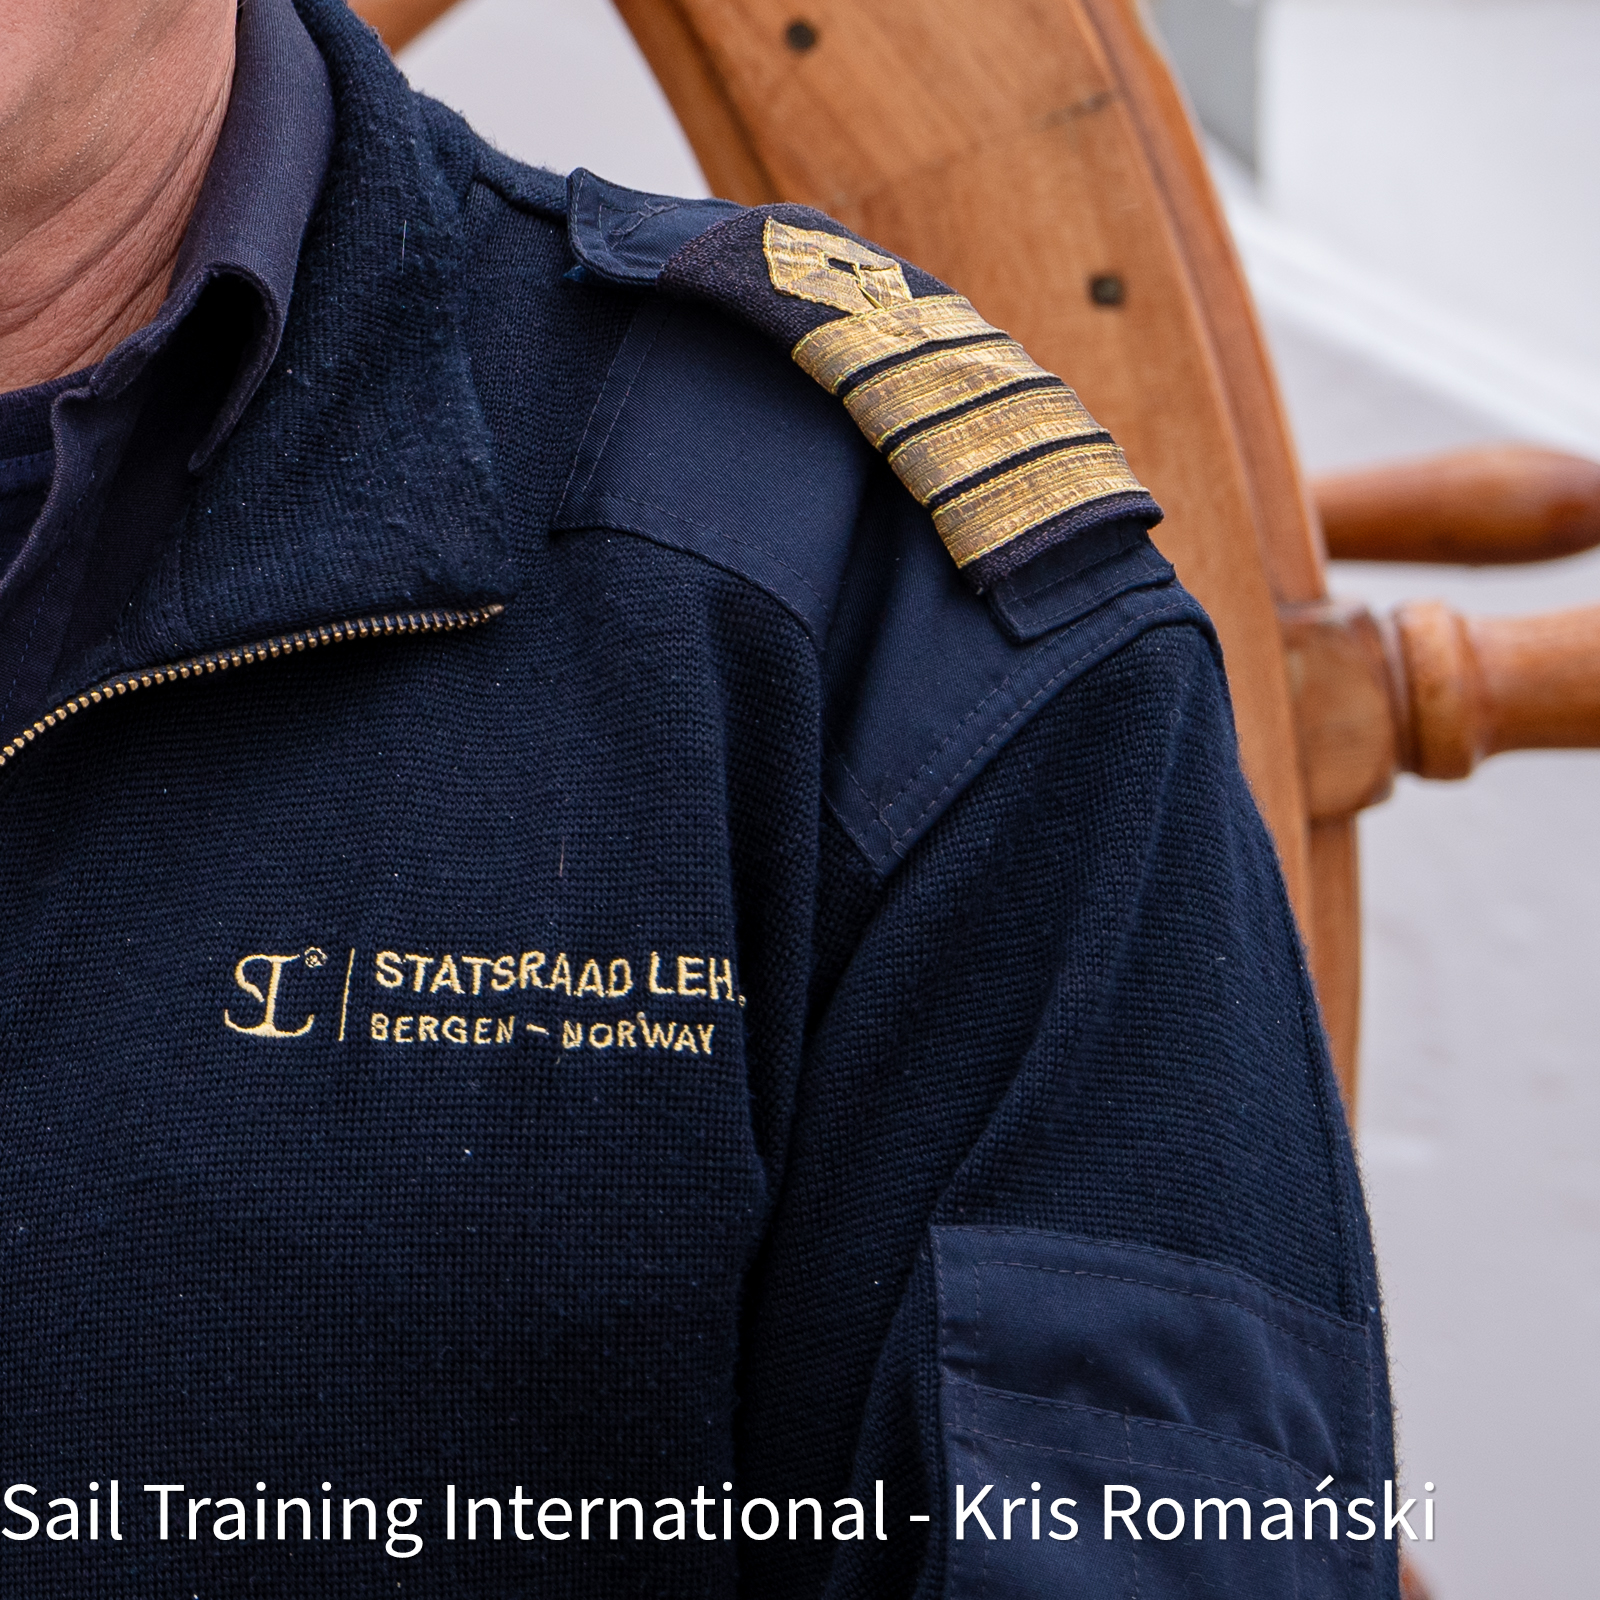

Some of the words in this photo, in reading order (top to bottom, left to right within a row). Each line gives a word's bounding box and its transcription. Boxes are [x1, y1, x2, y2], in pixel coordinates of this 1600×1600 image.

[375, 950, 633, 998] STATSRAAD
[649, 951, 747, 1007] LEH
[371, 1012, 515, 1045] BERGEN
[562, 1011, 715, 1055] NORWAY
